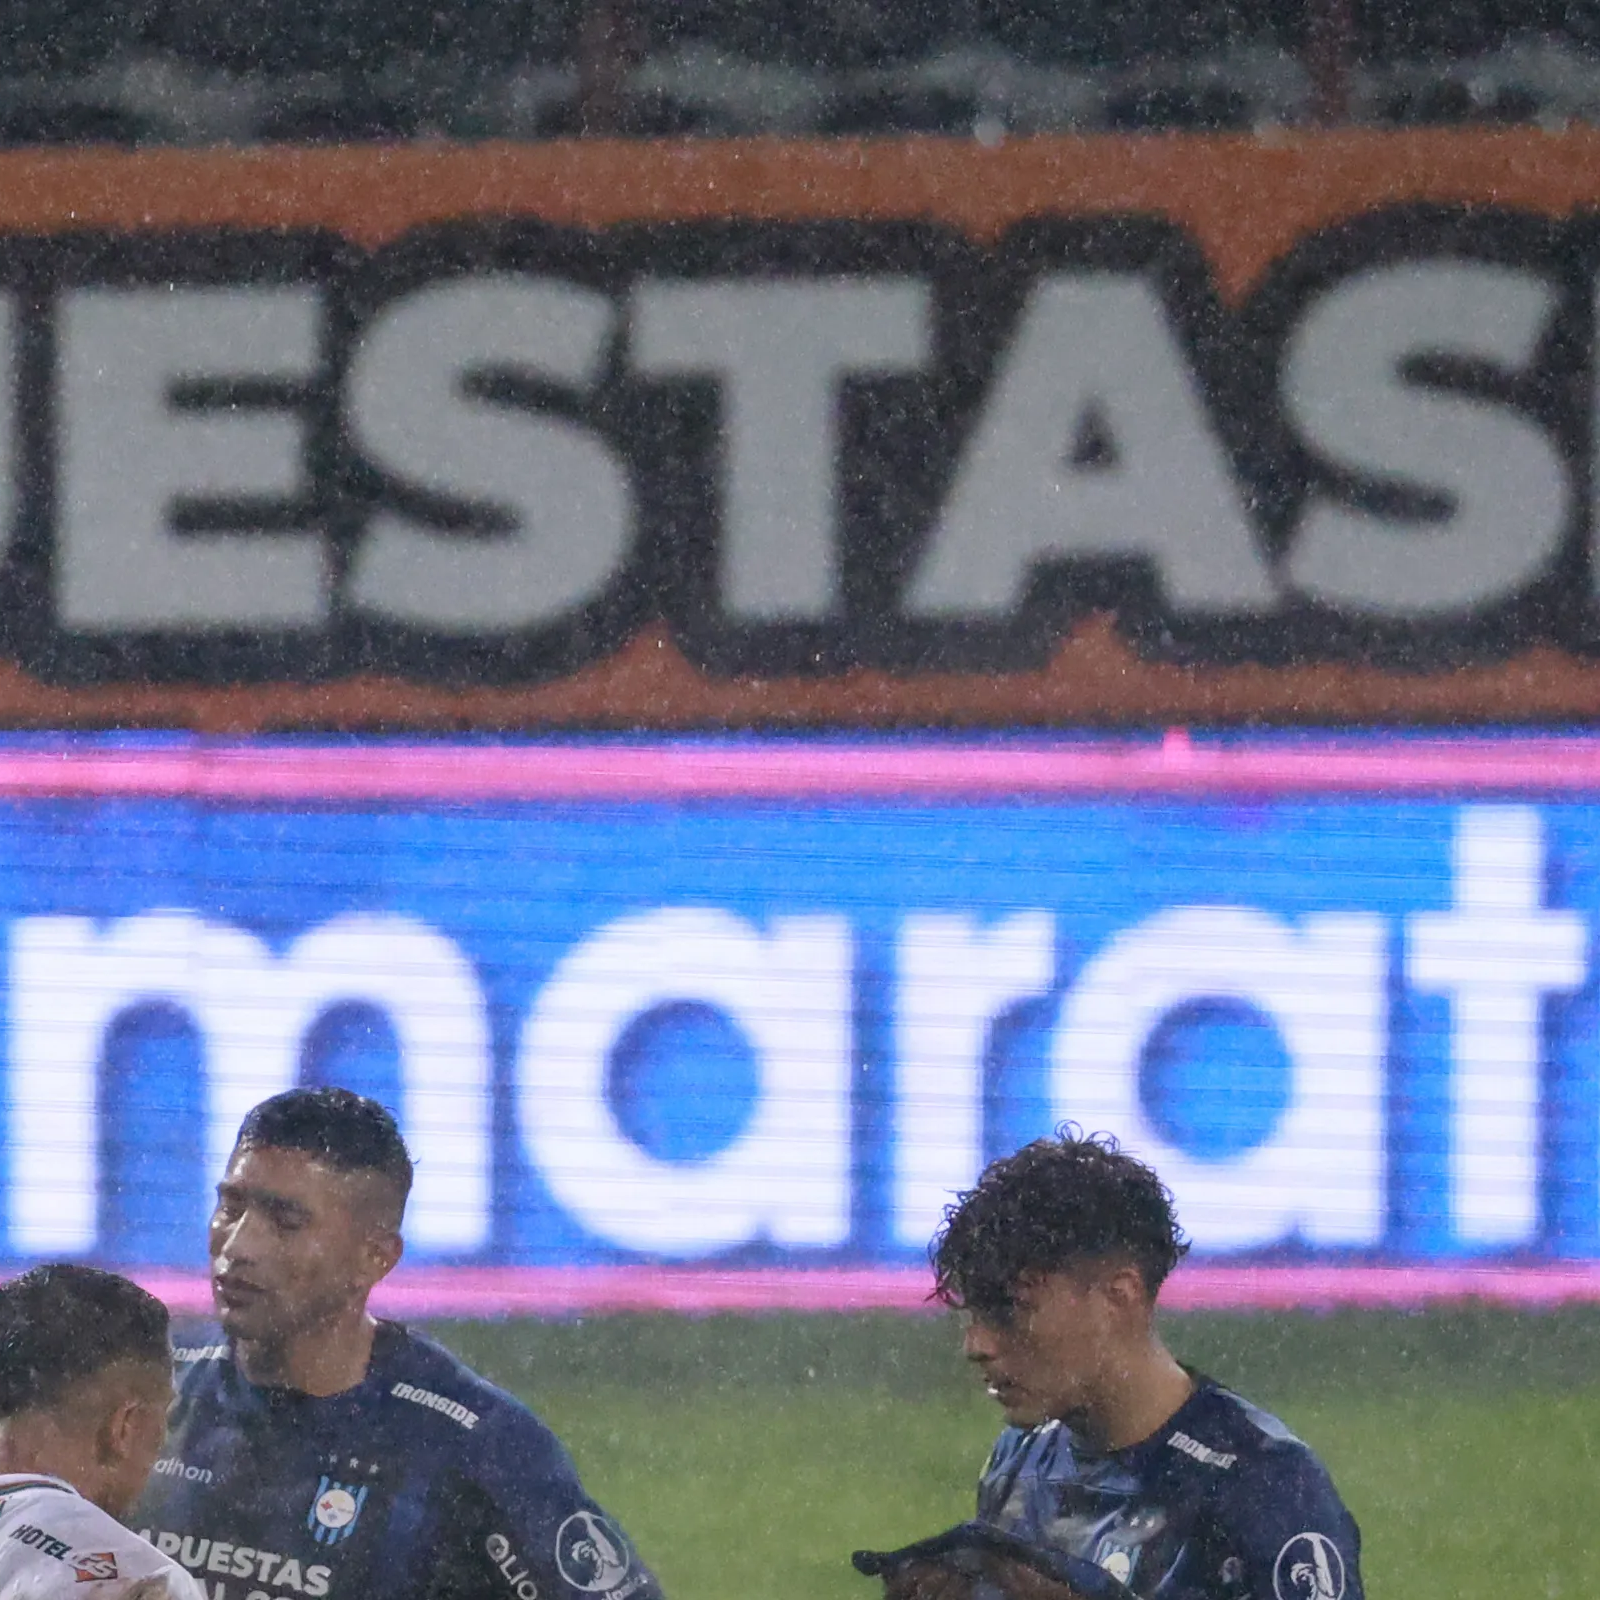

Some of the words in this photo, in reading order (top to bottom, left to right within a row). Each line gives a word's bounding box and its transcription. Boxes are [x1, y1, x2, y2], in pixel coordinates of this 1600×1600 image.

[390, 1382, 480, 1430] IRONSIDE
[153, 1456, 213, 1484] athon
[9, 1523, 74, 1562] HOTEL
